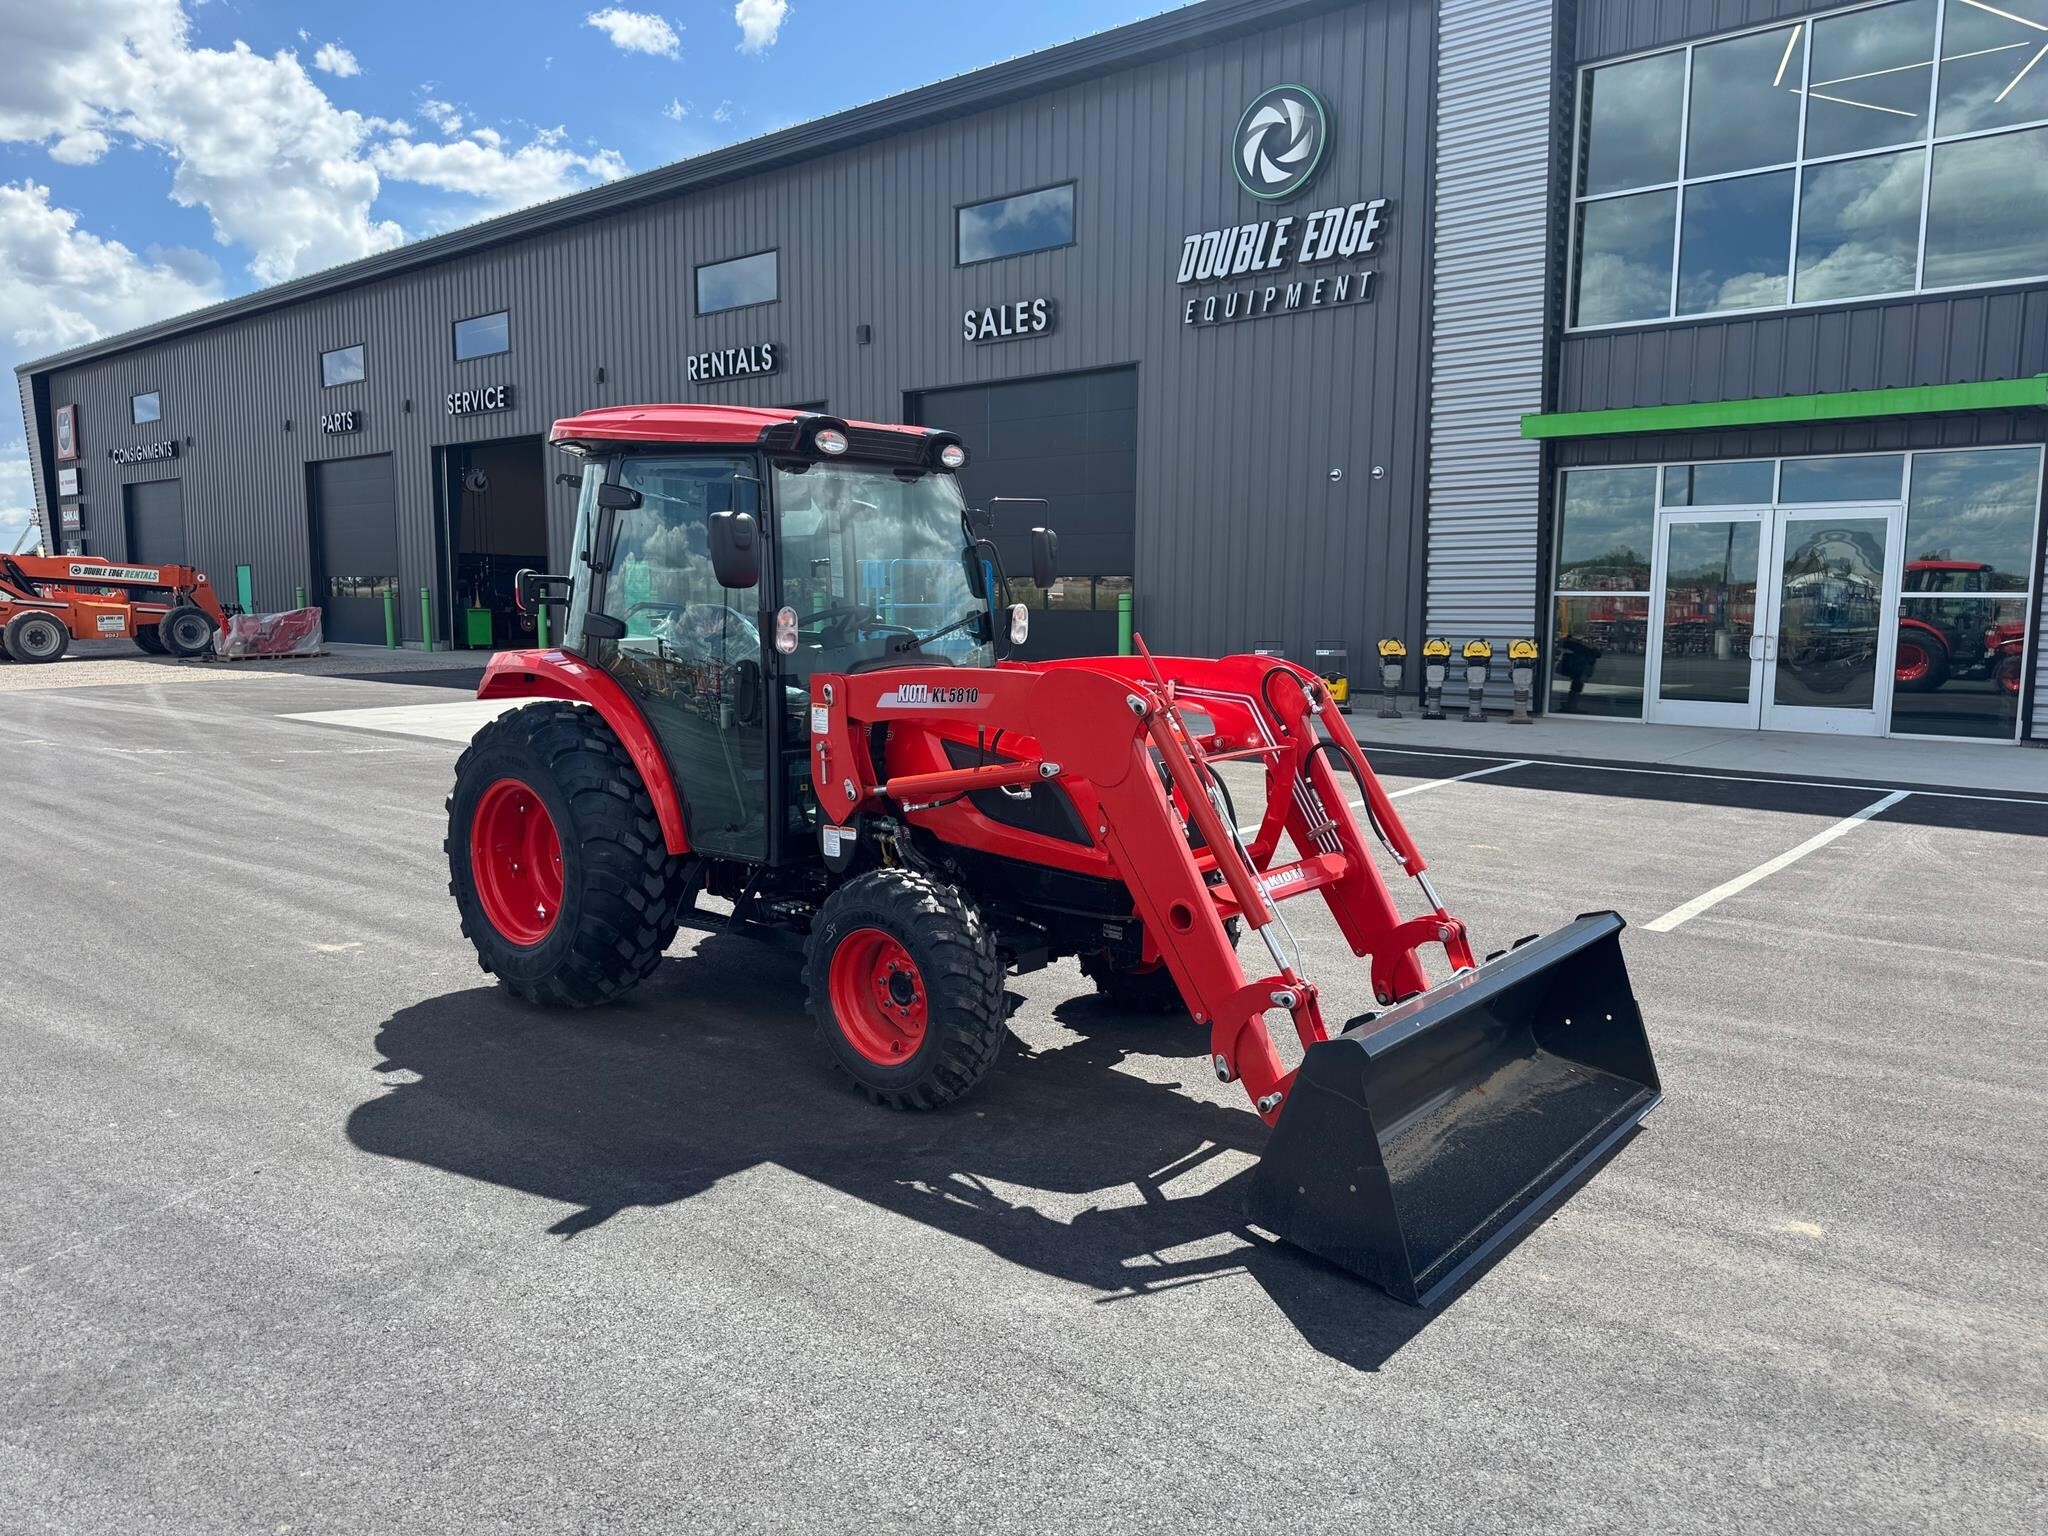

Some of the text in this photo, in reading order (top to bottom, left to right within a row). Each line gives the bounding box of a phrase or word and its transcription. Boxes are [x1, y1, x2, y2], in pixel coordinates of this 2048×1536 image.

[1176, 198, 1387, 284] DOUBLE EDGE
[1184, 270, 1373, 324] EQUIPMENT
[963, 298, 1047, 341] SALES
[687, 343, 773, 381] RENTALS
[447, 386, 505, 415] SERVICE
[321, 411, 353, 434] PARTS
[113, 440, 173, 464] CONSIGNMENTS
[62, 510, 78, 522] SAKAI
[83, 567, 158, 580] DOUBLE EDGE RENTALS
[897, 684, 928, 703] KIOTI
[1267, 867, 1305, 887] KIOTI
